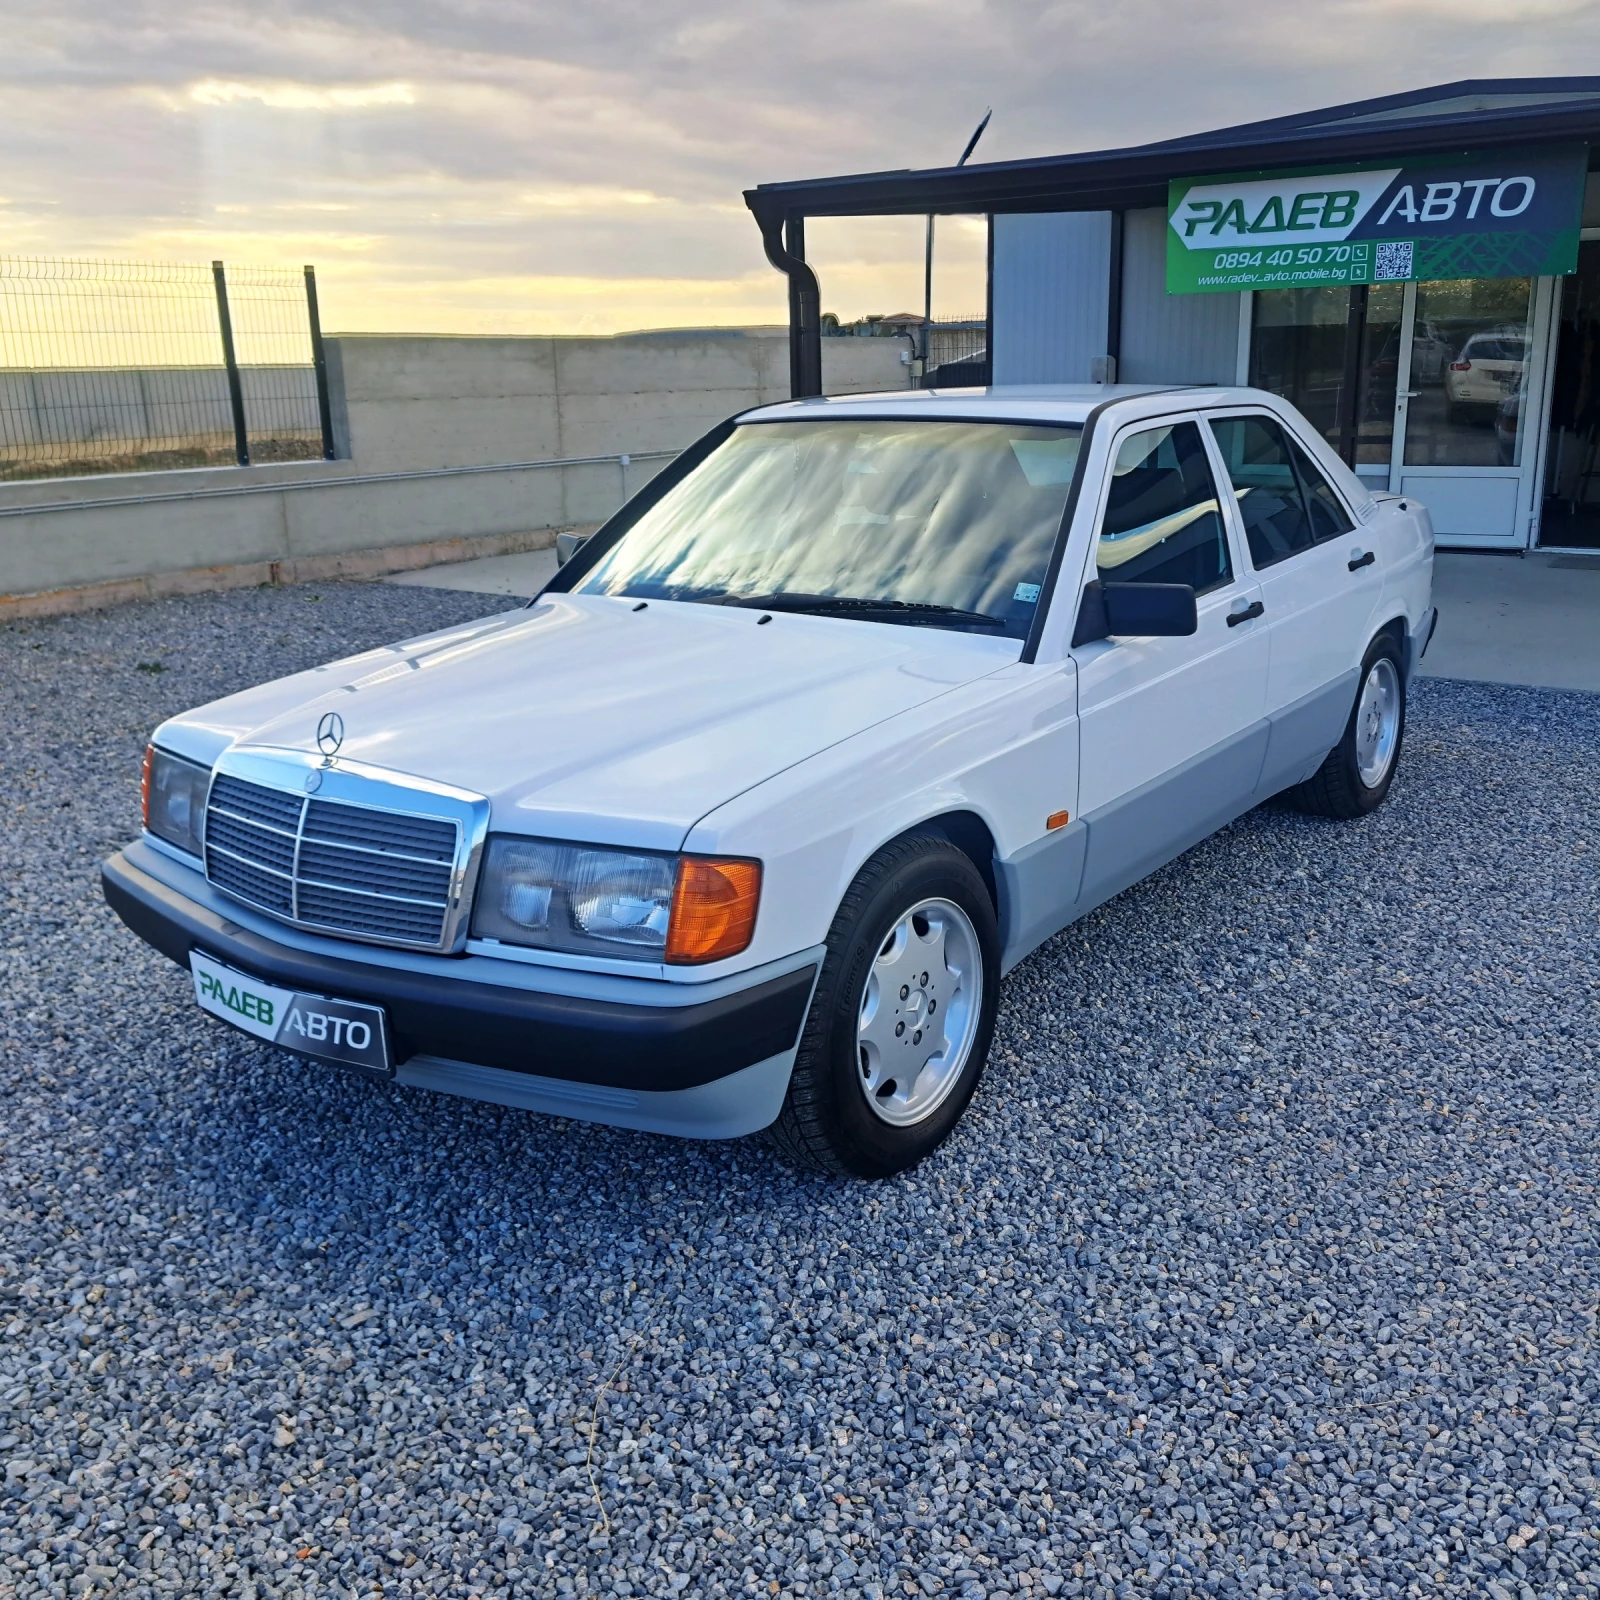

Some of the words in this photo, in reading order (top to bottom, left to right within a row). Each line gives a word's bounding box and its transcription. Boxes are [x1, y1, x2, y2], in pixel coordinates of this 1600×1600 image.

[1184, 189, 1361, 236] РАДЕВ
[1377, 176, 1536, 226] АВТО
[1197, 267, 1347, 286] www.radev_avto.mobile.bg
[1213, 251, 1263, 270] 0894
[1265, 249, 1293, 266] 40
[1295, 247, 1322, 265] 50
[1324, 245, 1351, 263] 70
[197, 969, 274, 1026] РАДЕВ
[284, 1007, 371, 1050] АВТО
